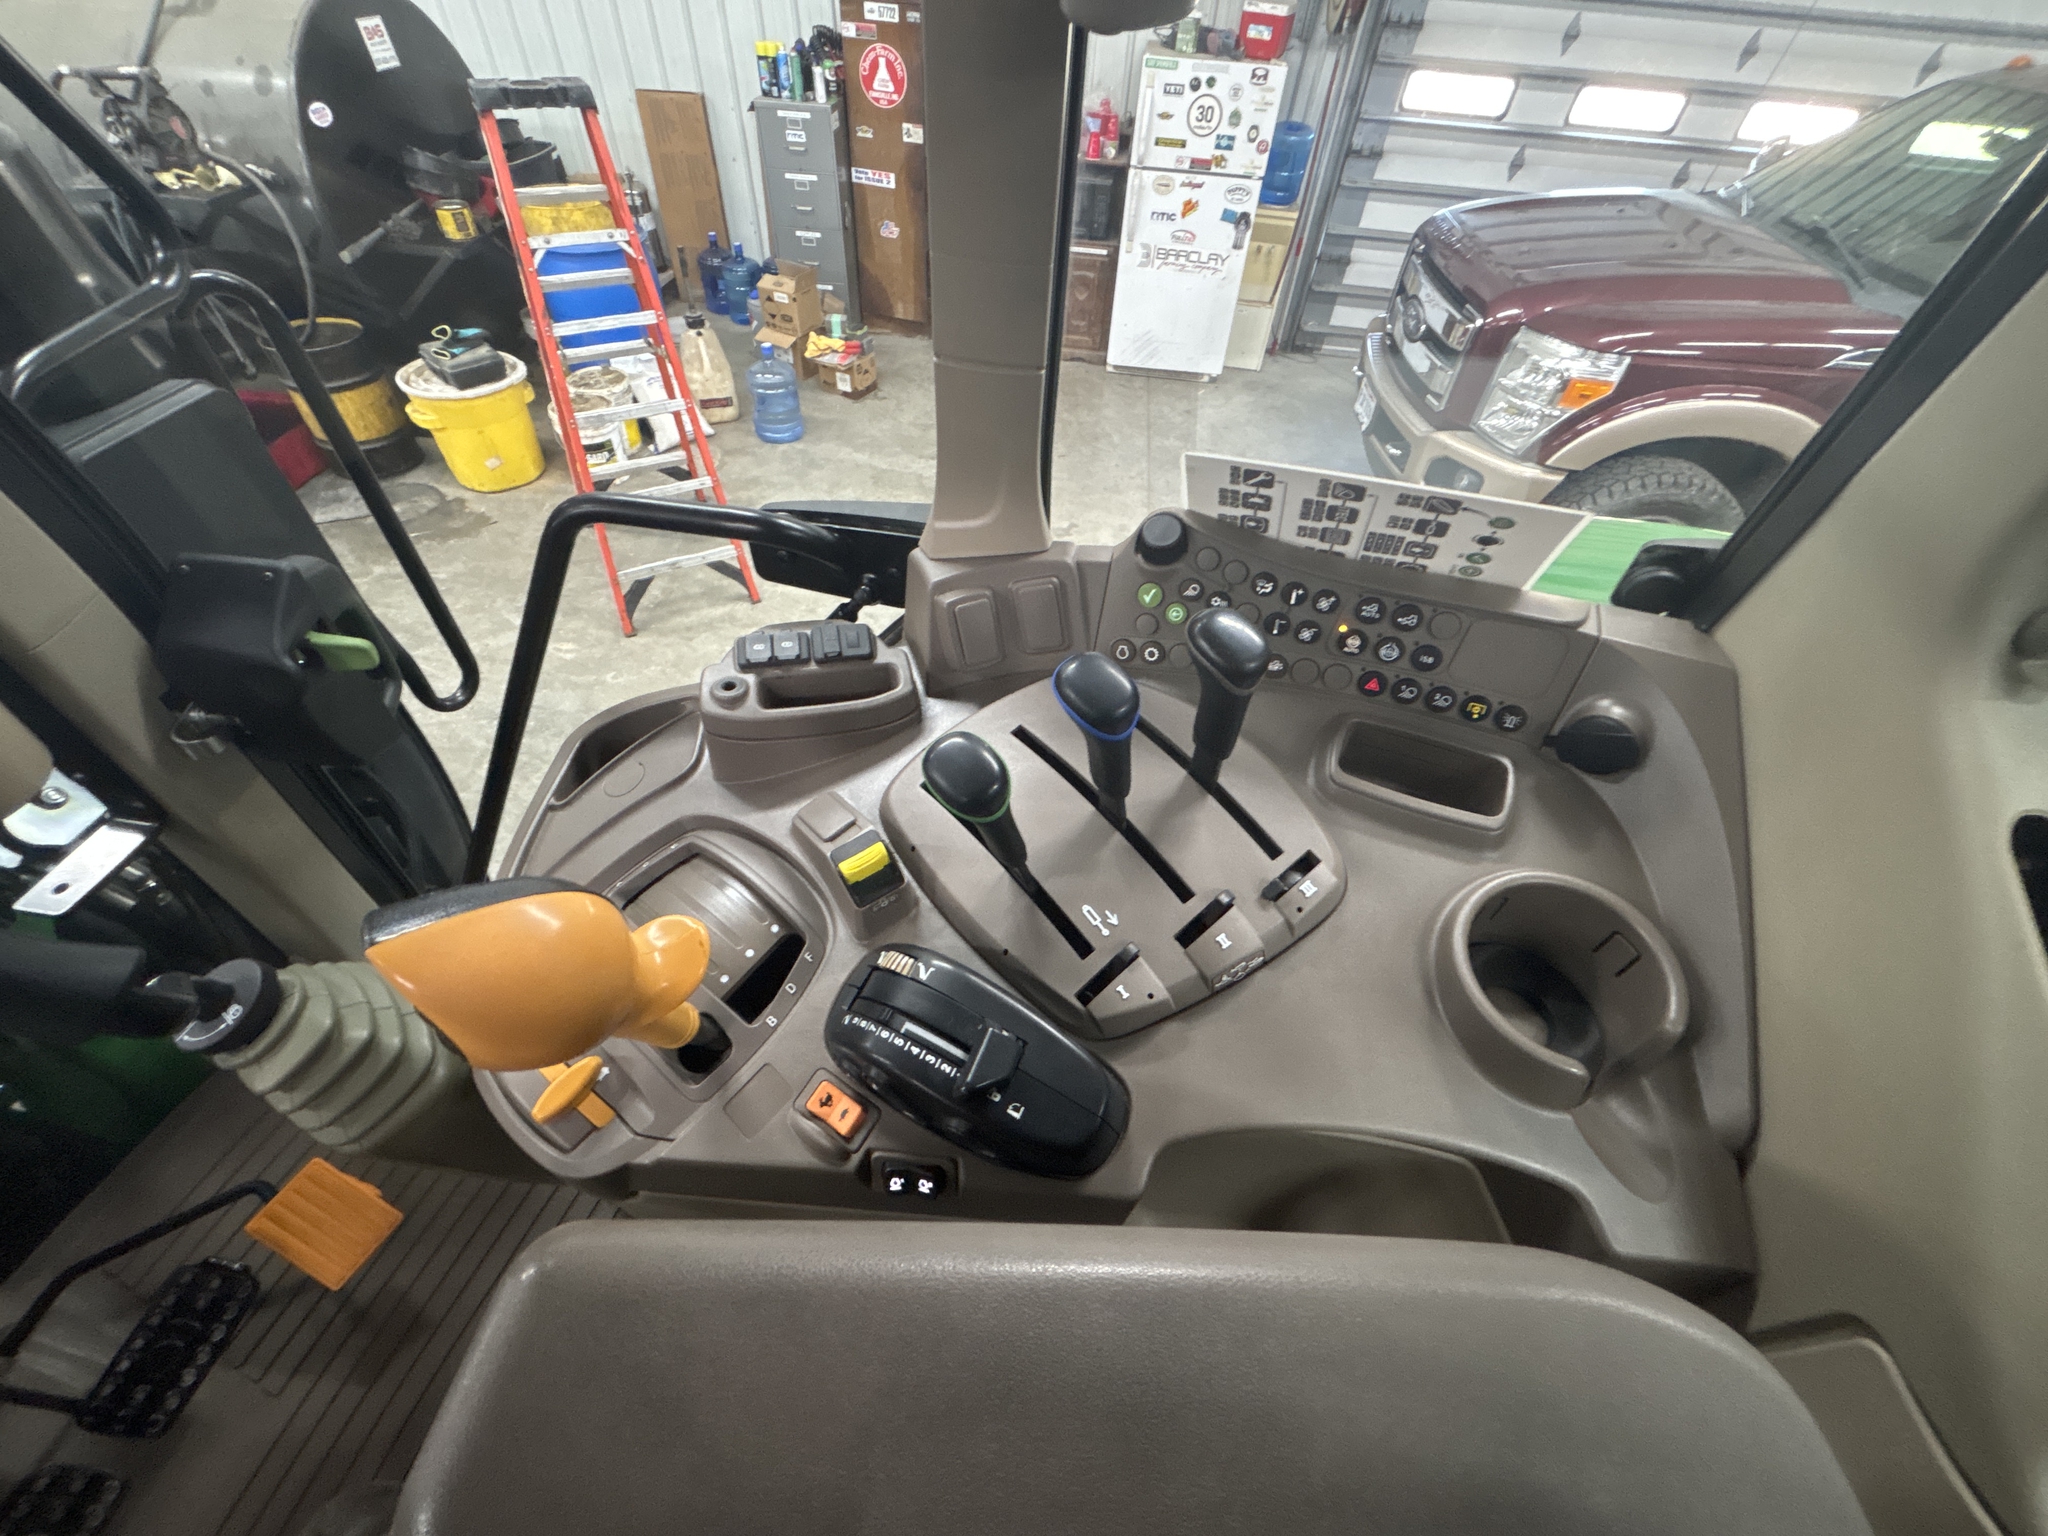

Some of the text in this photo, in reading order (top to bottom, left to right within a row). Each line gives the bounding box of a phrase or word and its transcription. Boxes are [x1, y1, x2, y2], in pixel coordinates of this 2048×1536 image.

[877, 6, 896, 19] 57722
[1164, 84, 1183, 94] YETI
[1195, 104, 1215, 123] 30
[853, 168, 891, 179] Vote YES
[1156, 247, 1230, 267] BARCLAY
[804, 951, 813, 962] F
[784, 982, 797, 994] D
[765, 1015, 778, 1027] B
[880, 1029, 890, 1038] 6
[893, 1037, 905, 1046] 5
[910, 1045, 921, 1055] 4
[925, 1054, 936, 1064] 3
[940, 1063, 952, 1073] 2
